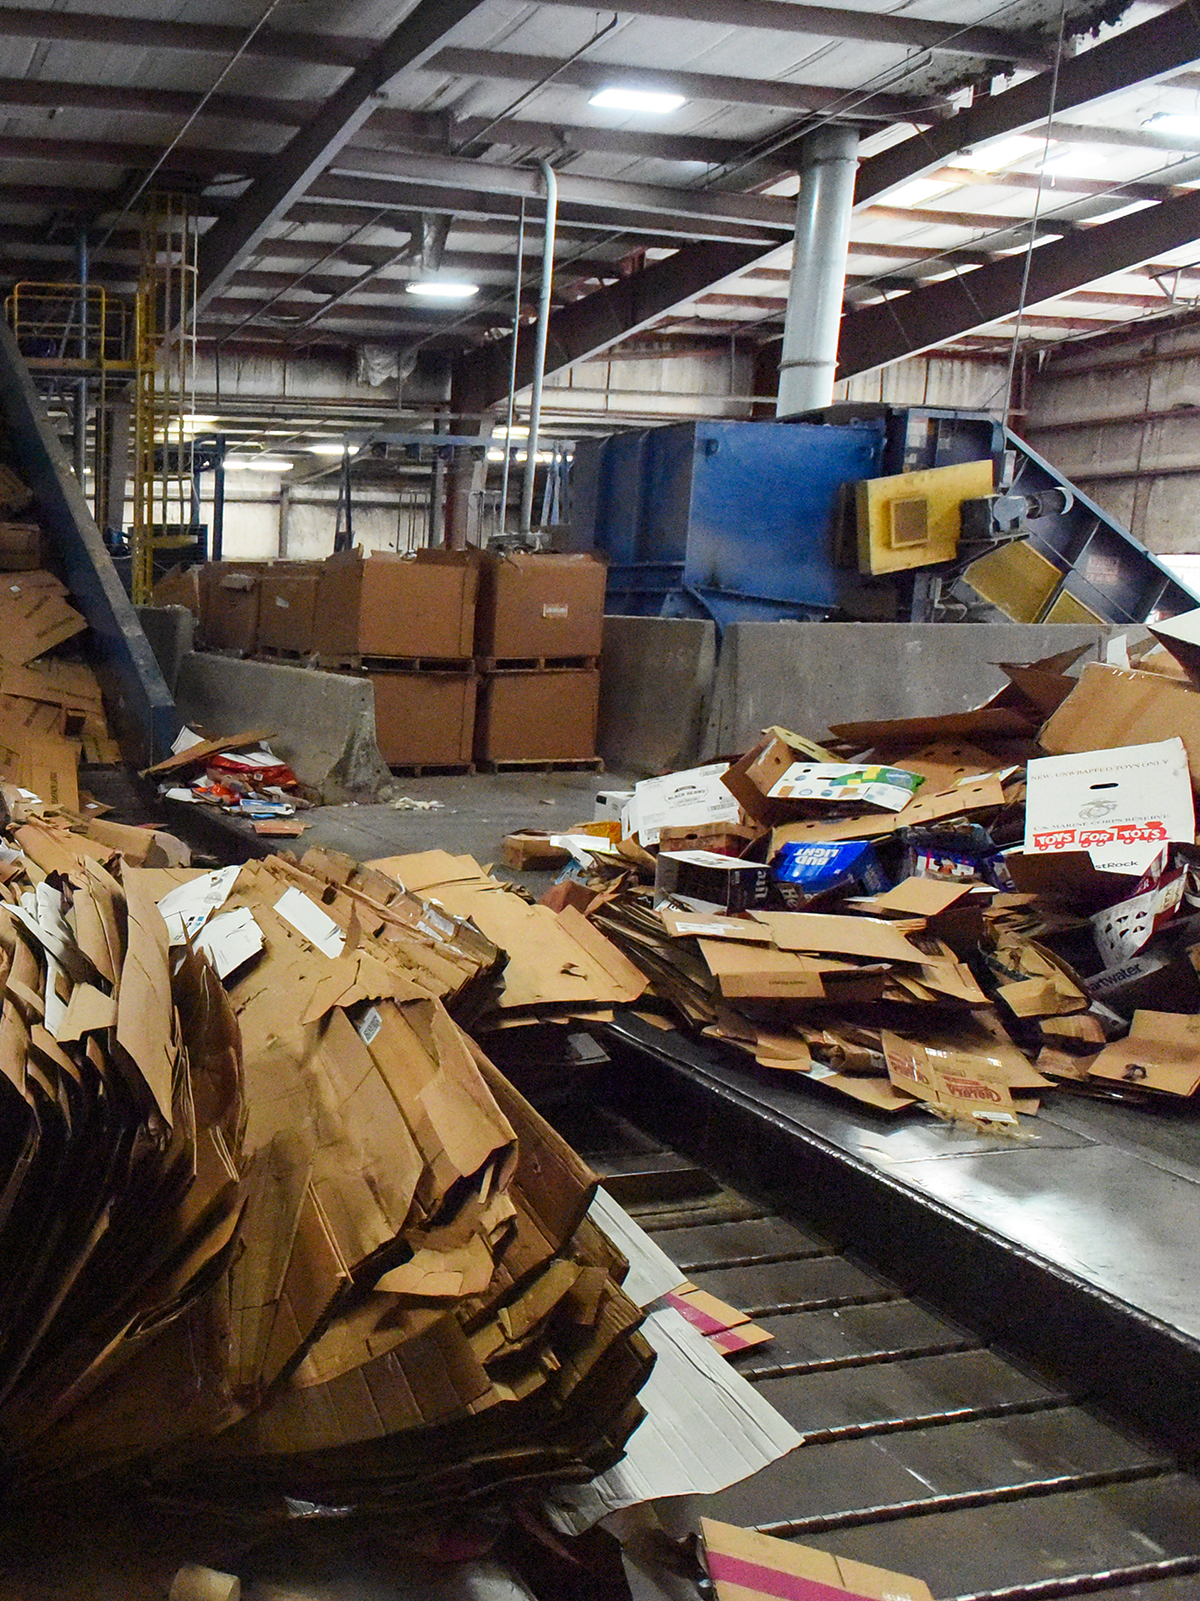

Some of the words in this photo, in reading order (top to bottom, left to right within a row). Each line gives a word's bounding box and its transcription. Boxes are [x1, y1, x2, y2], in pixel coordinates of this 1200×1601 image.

[1055, 766, 1113, 778] UNWRAPPED
[1115, 763, 1140, 771] TOYS
[1141, 759, 1169, 768] ONLY
[1052, 821, 1087, 829] MARINE
[1090, 818, 1124, 826] CORPS
[1125, 814, 1170, 822] RESERVE
[1037, 833, 1073, 845] TOYS
[1081, 832, 1111, 842] FOR
[1119, 828, 1161, 840] TOTS
[793, 848, 840, 858] LIGHT
[794, 856, 831, 866] BUD
